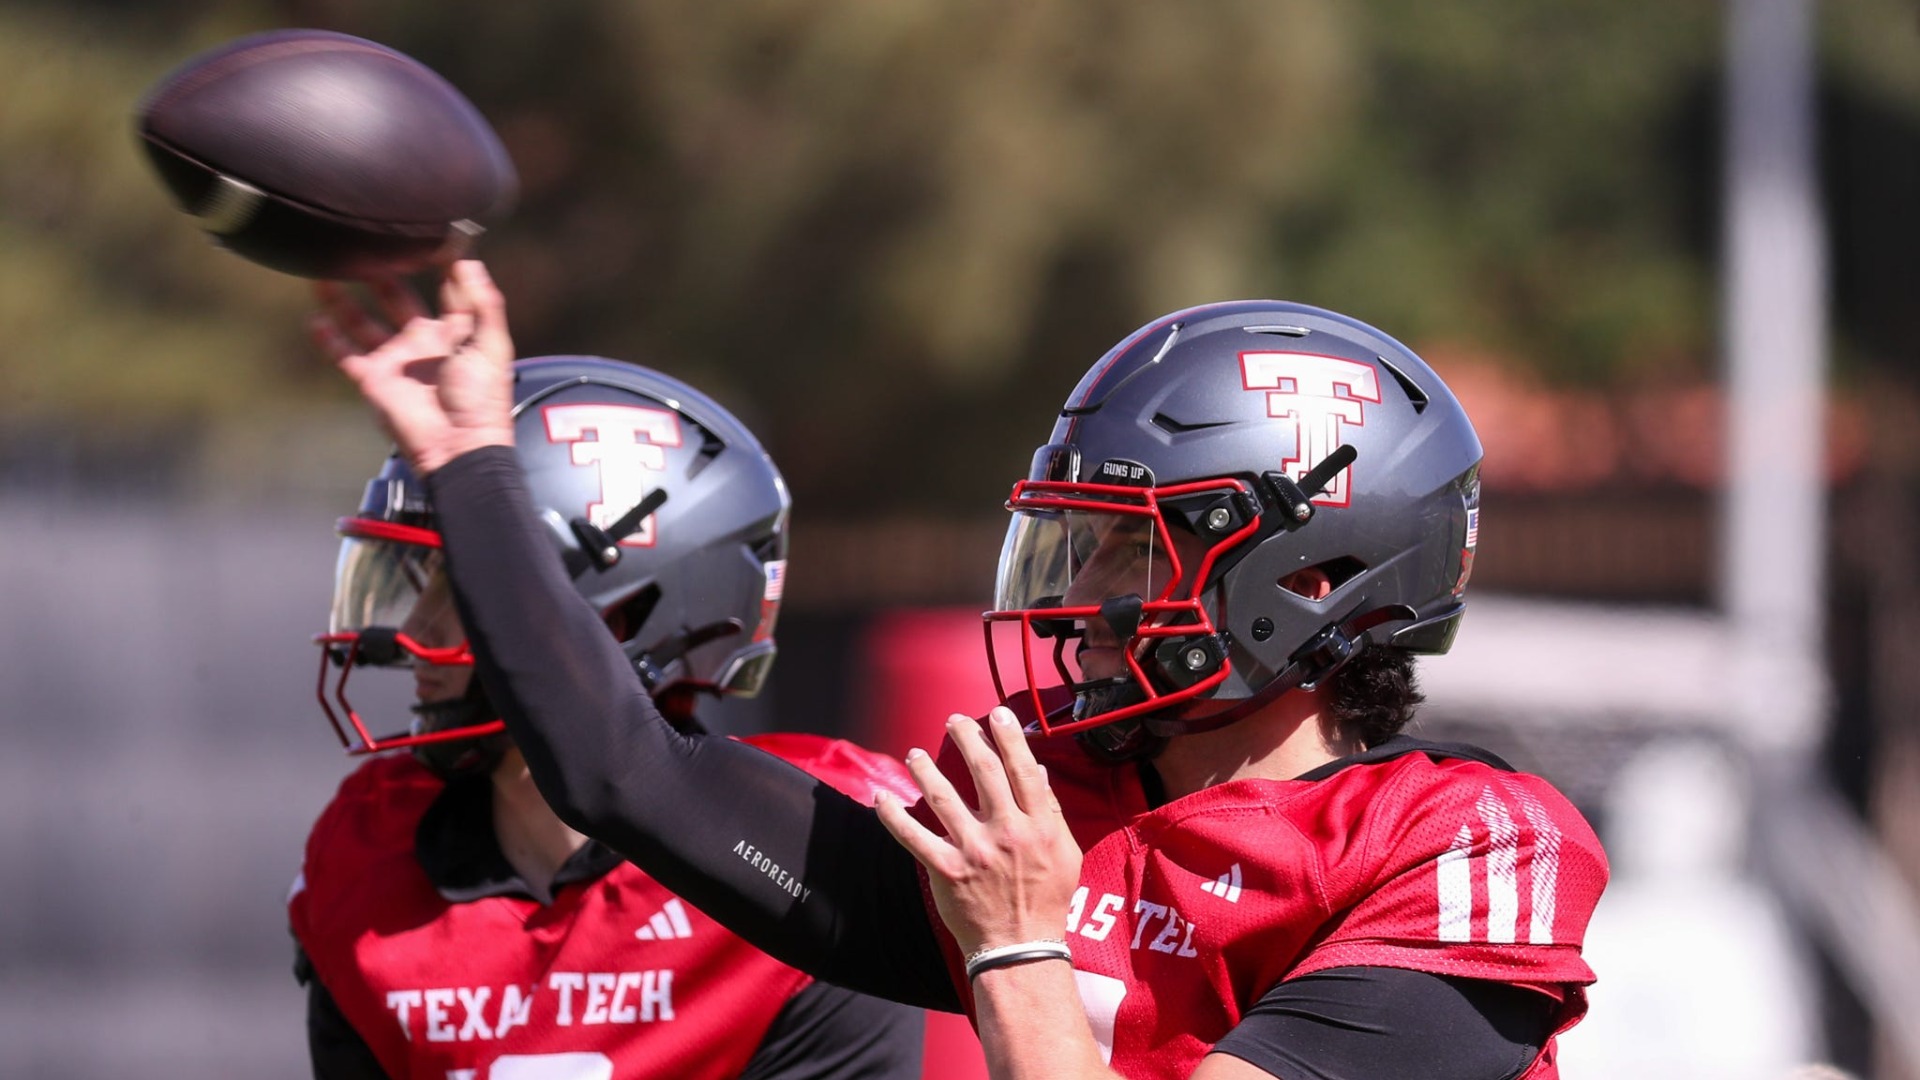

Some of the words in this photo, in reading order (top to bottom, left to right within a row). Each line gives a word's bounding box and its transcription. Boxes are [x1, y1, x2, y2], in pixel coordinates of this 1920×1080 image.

[1103, 462, 1128, 477] GUNS
[1130, 466, 1144, 479] UP
[733, 840, 811, 903] AEROREADY
[386, 985, 536, 1042] TEXA
[549, 969, 675, 1026] TECH
